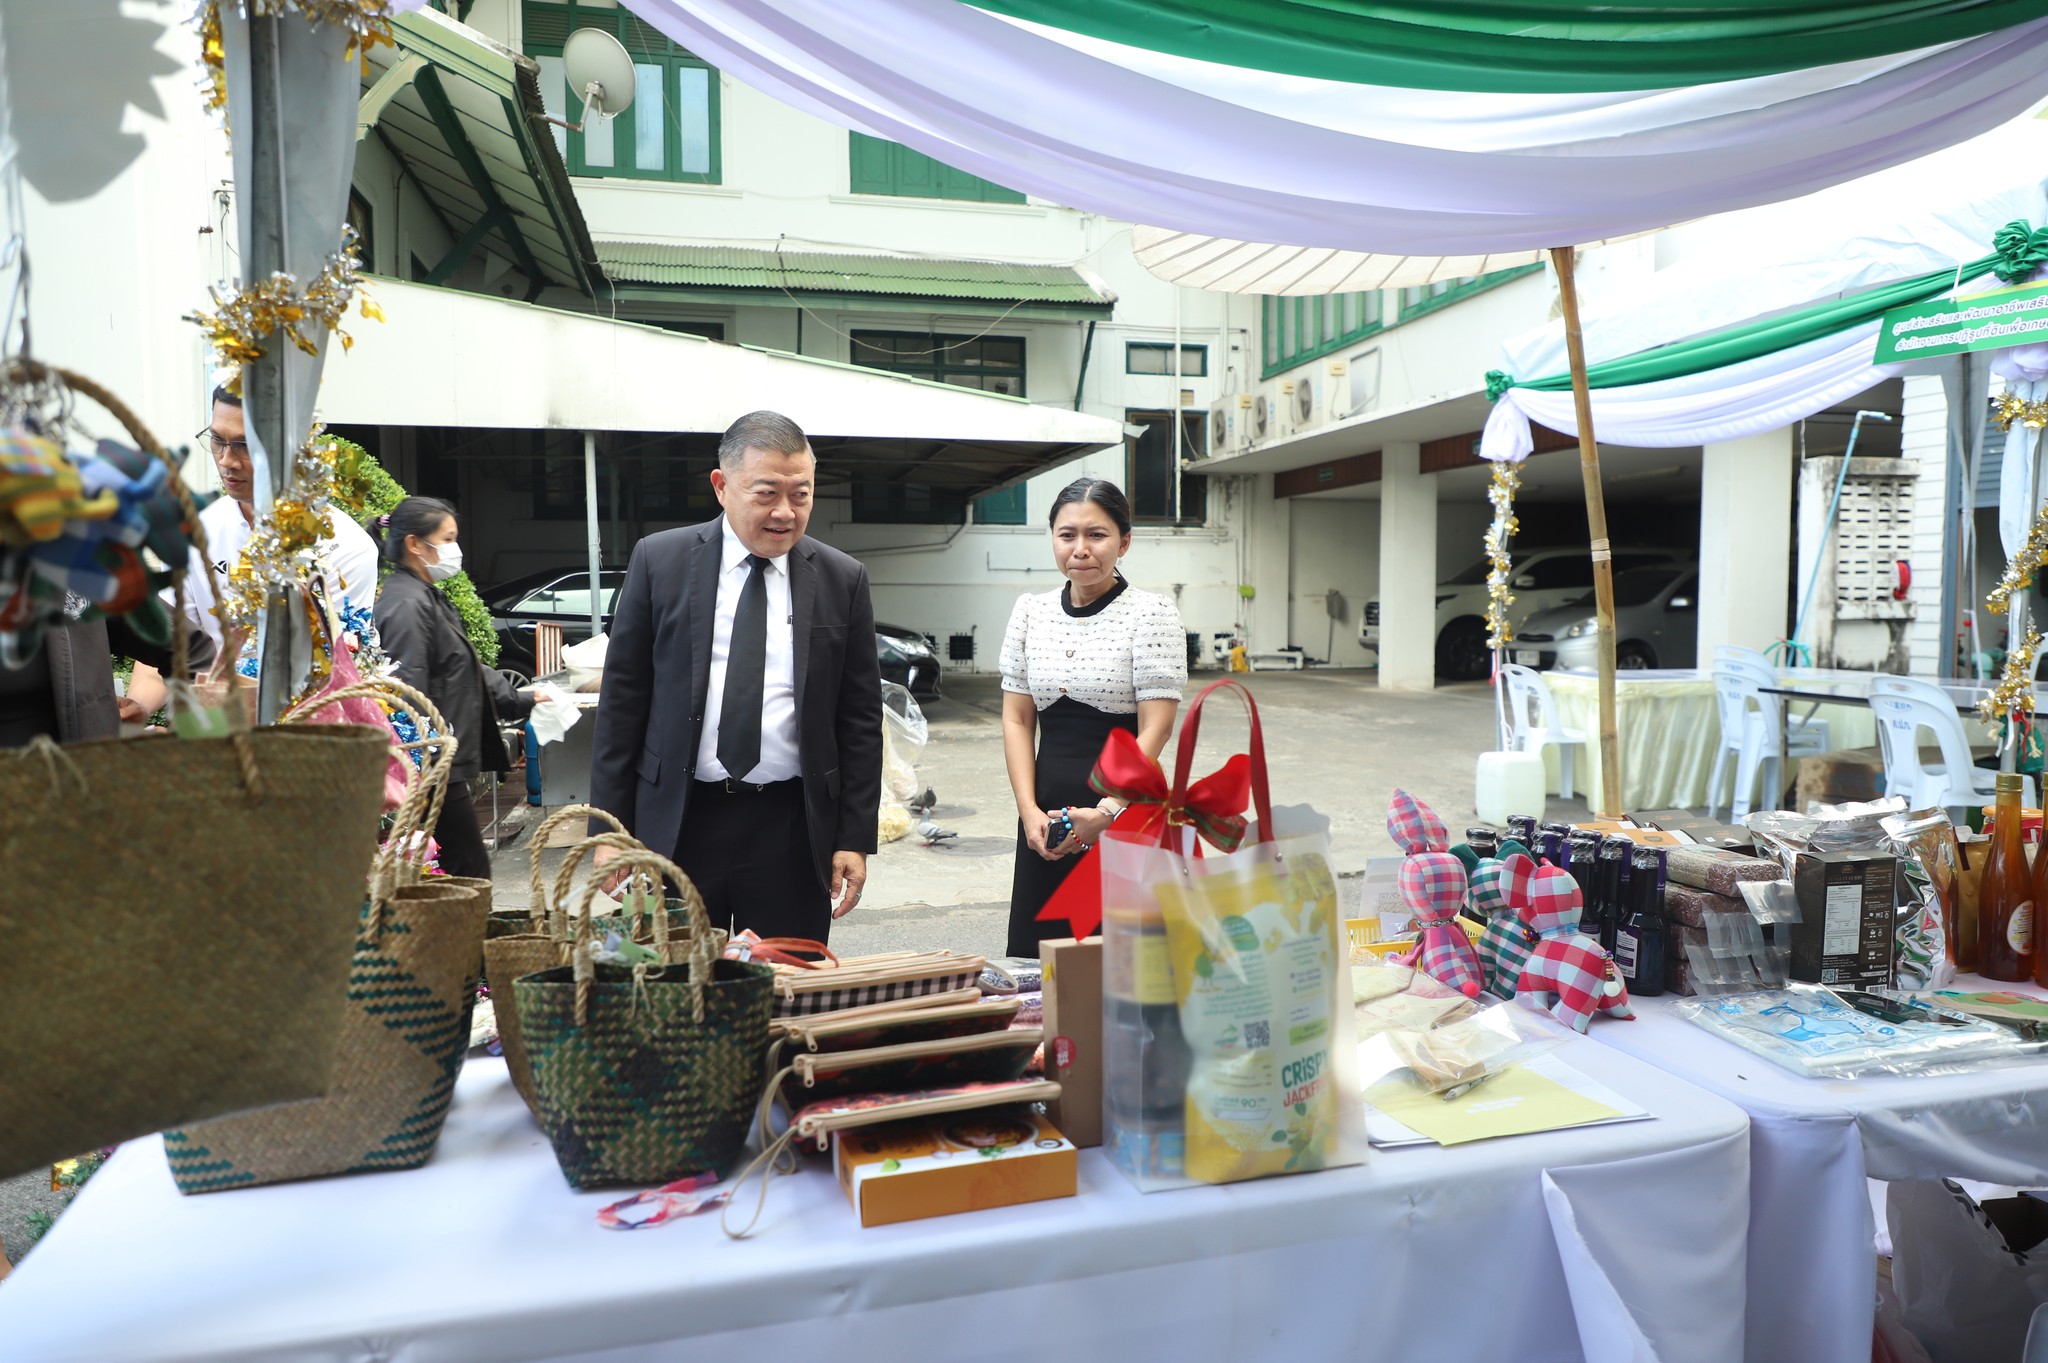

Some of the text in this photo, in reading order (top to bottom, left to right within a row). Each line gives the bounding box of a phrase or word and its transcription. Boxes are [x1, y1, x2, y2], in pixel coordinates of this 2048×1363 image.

[1896, 318, 2048, 350] สำนักงานการปฏิรูปที่ดินเพื่อเกษ
